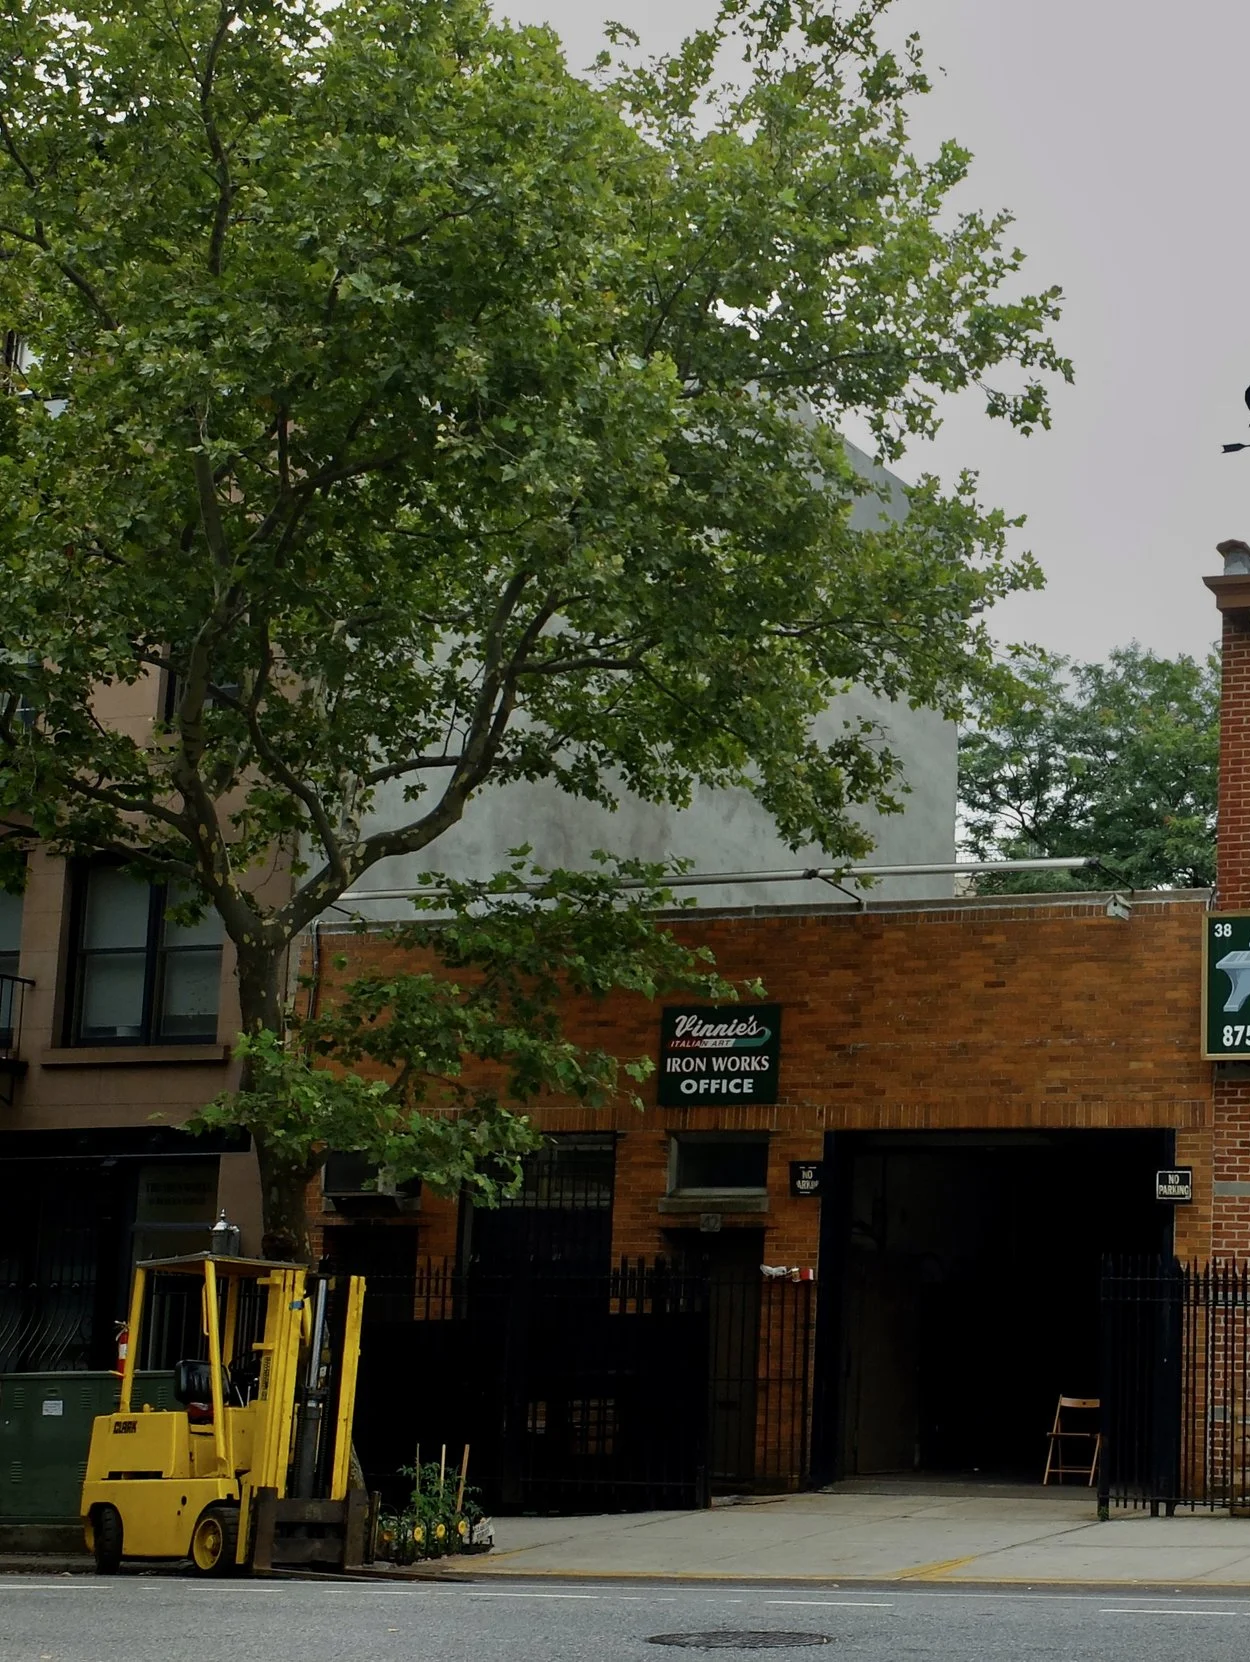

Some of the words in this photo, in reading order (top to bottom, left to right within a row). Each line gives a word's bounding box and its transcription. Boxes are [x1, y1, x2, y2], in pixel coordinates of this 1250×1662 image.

[1214, 924, 1232, 937] 38
[675, 1015, 762, 1038] Vinnie's
[670, 1040, 709, 1048] ITALIAN
[666, 1057, 707, 1072] IRON
[711, 1055, 770, 1072] WORKS
[680, 1078, 754, 1094] OFFICE
[802, 1170, 813, 1179] NO
[1168, 1174, 1179, 1184] NO
[1158, 1184, 1189, 1195] PARKING
[113, 1420, 138, 1434] CLARK
